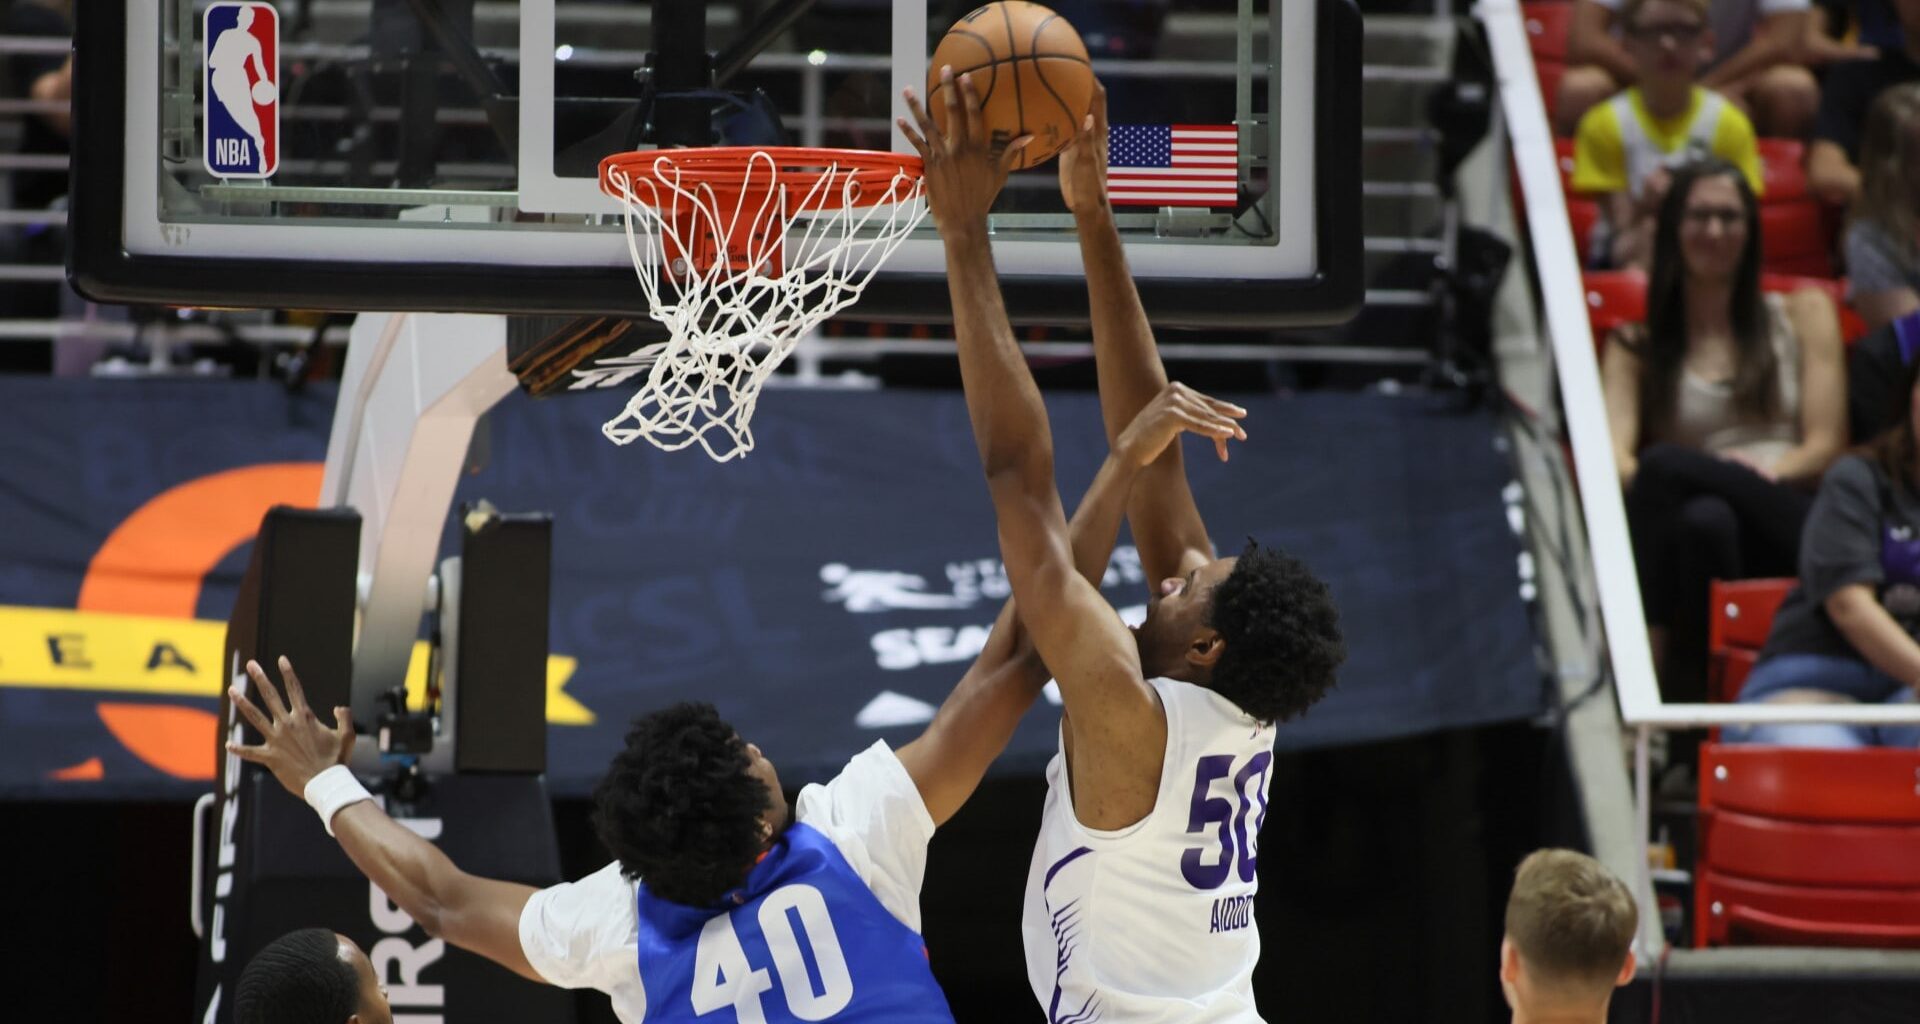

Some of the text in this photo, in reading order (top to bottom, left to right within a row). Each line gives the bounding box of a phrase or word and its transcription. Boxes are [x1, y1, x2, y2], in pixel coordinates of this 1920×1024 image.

[215, 138, 251, 165] NBA
[1181, 750, 1272, 890] 50
[690, 883, 854, 1024] 40
